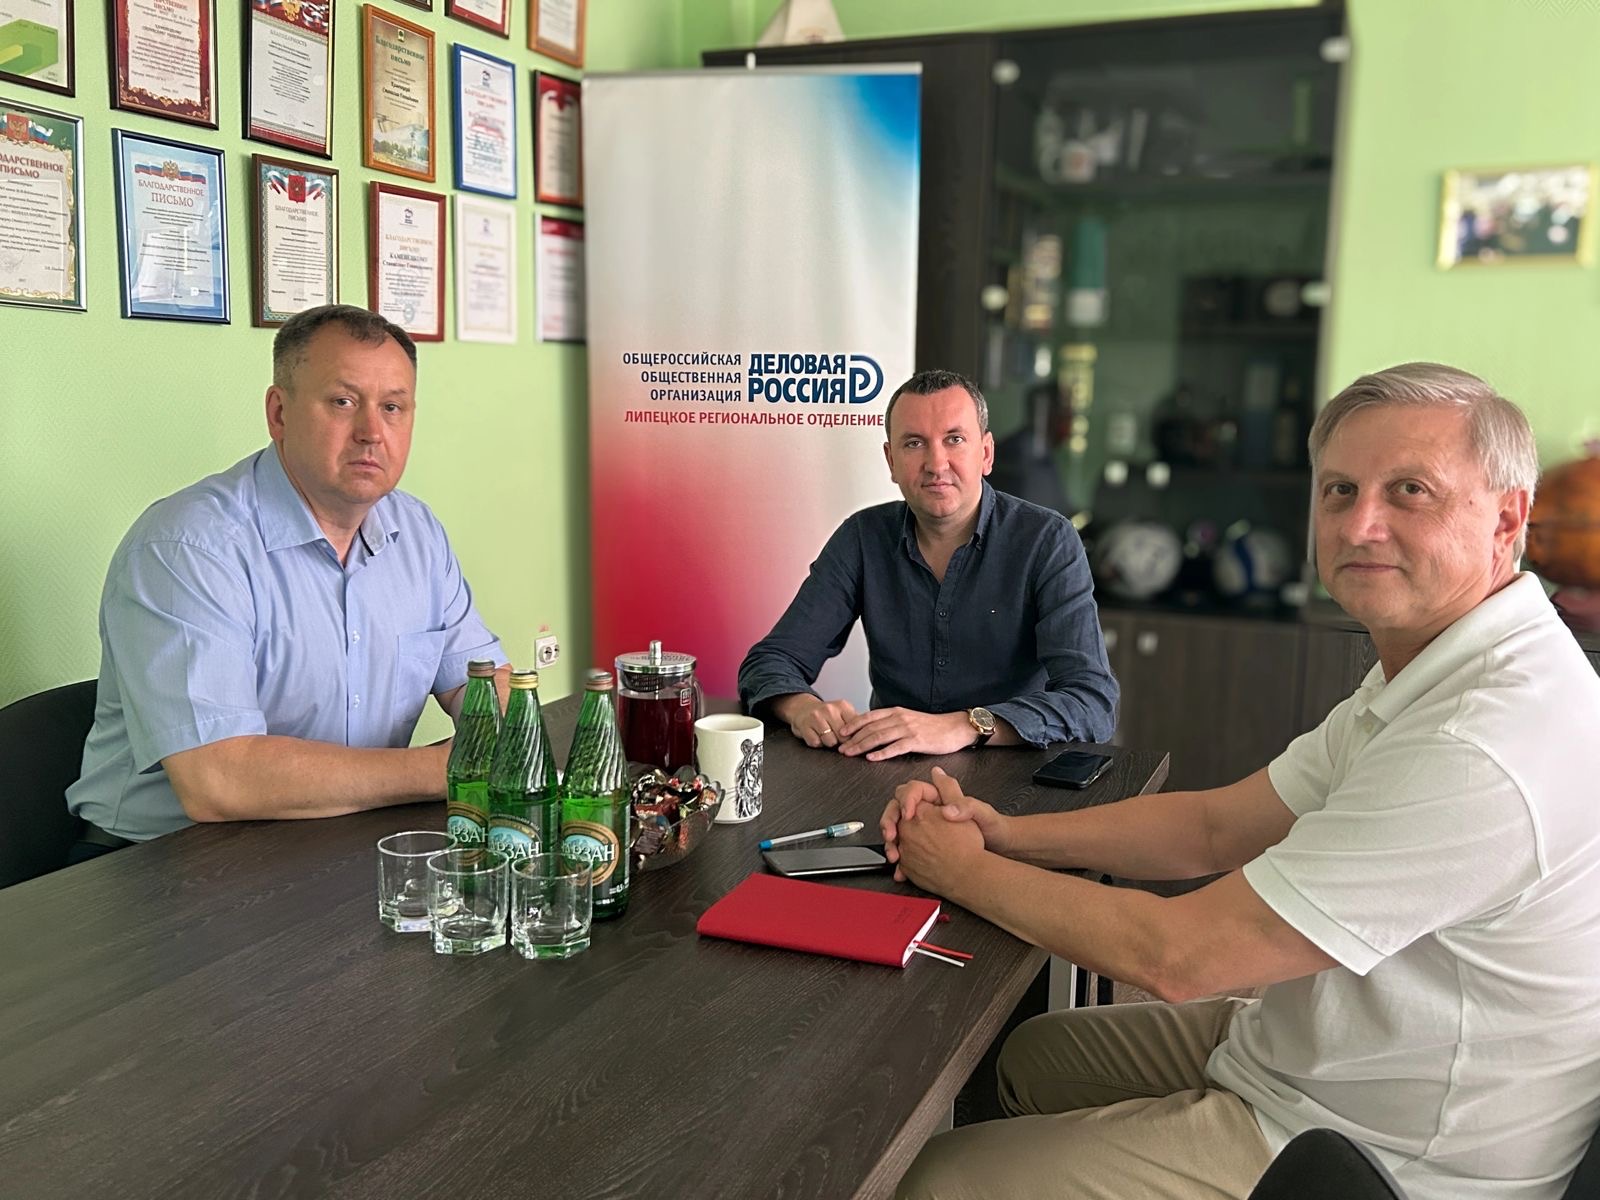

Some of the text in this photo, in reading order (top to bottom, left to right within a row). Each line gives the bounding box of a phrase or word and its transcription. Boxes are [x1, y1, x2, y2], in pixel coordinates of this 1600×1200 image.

[0, 164, 40, 179] ПИСЬМО
[138, 179, 205, 196] БЛАГОДАРСТВЕННОЕ
[151, 192, 194, 207] ПИСЬМО
[622, 352, 742, 366] ОБЩЕРОССИЙСКАЯ
[748, 353, 846, 376] ДЕЛОВАЯ
[641, 371, 742, 385] ОБЩЕСТВЕННАЯ
[650, 389, 742, 403] ОРГАНИЗАЦИЯ
[748, 378, 846, 404] РОССИЯ
[624, 410, 885, 427] ЛИПЕЦКОЕ РЕГИОНАЛЬНОЕ ОТДЕЛЕНИЕ
